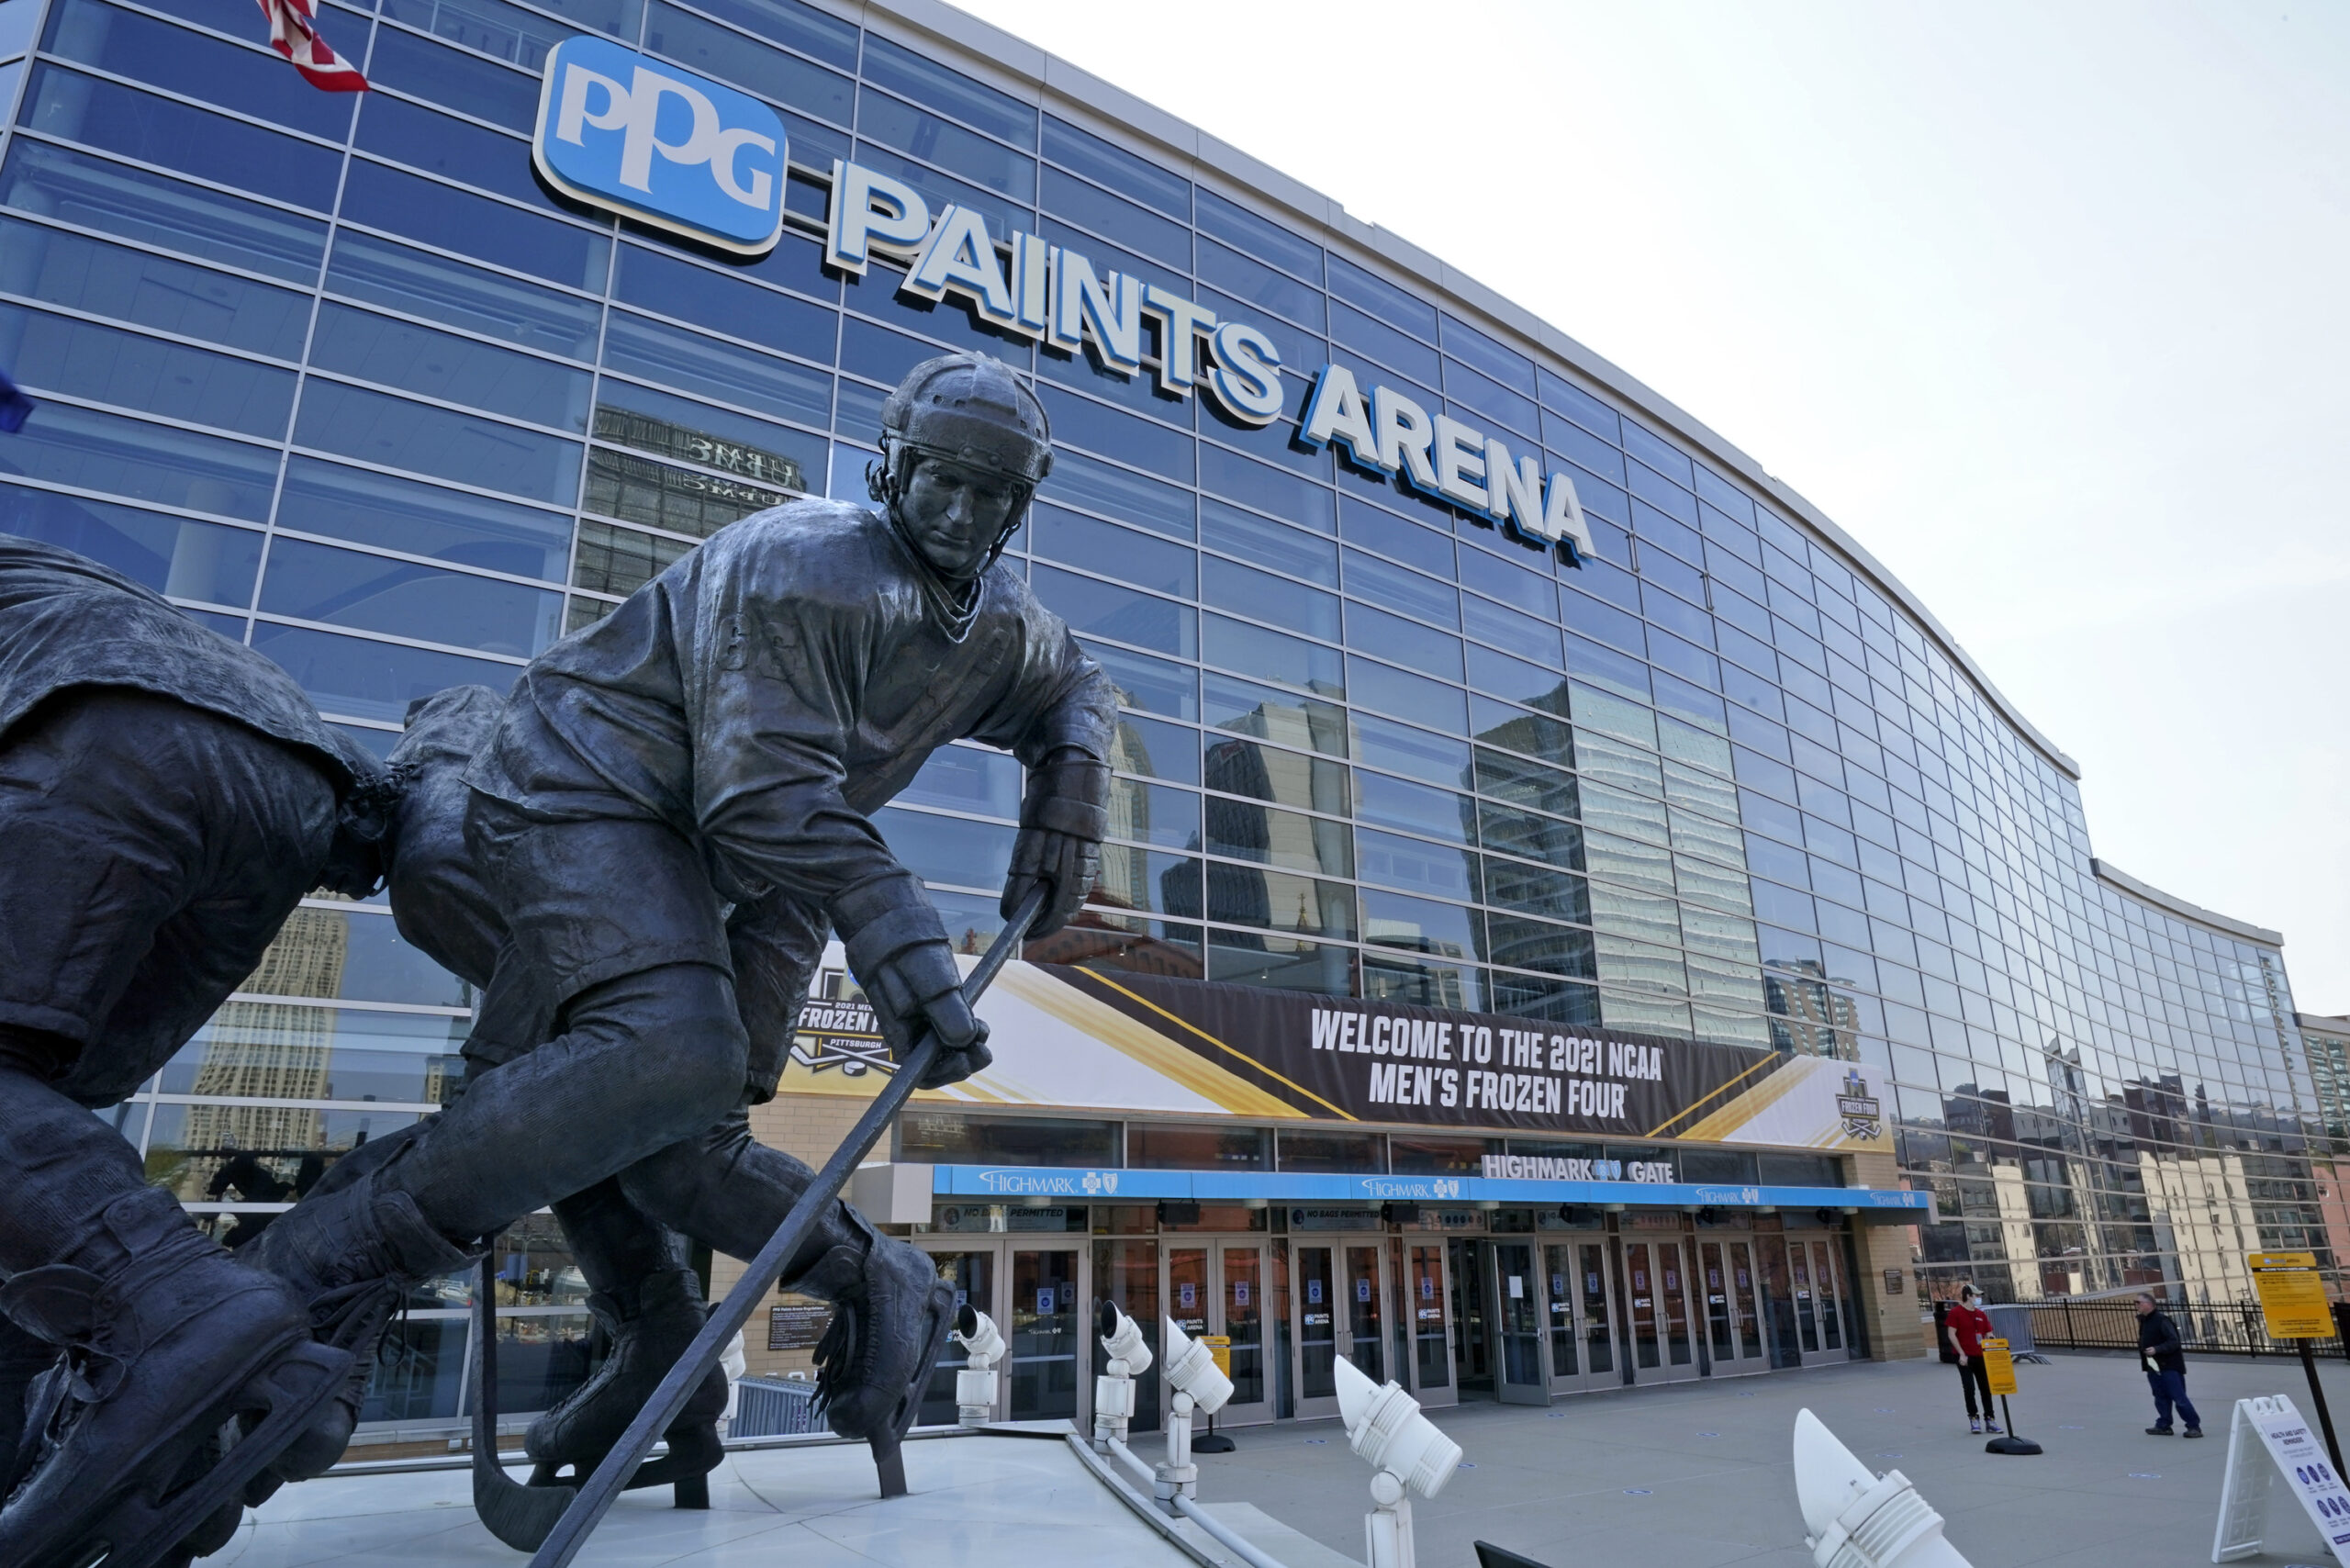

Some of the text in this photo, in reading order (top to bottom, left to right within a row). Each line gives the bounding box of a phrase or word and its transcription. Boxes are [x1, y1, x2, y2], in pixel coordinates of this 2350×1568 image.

[555, 62, 1597, 562] PPG PAINTS ARENA
[798, 1007, 870, 1032] FROZEN
[834, 1002, 874, 1012] 2021 MEN
[830, 1038, 882, 1049] PITTSBURGH
[1311, 1008, 1452, 1061] WELCOME
[1460, 1024, 1493, 1064] TO
[1499, 1028, 1544, 1070] THE
[1550, 1035, 1603, 1075] 2021
[1369, 1061, 1459, 1107] MEN'S
[1465, 1070, 1561, 1114] FROZEN
[1481, 1154, 1674, 1183] HIGHMARK GATE
[1010, 1208, 1064, 1217] PERMITTED
[1306, 1210, 1318, 1218] NO
[1340, 1210, 1380, 1219] PERMITTED
